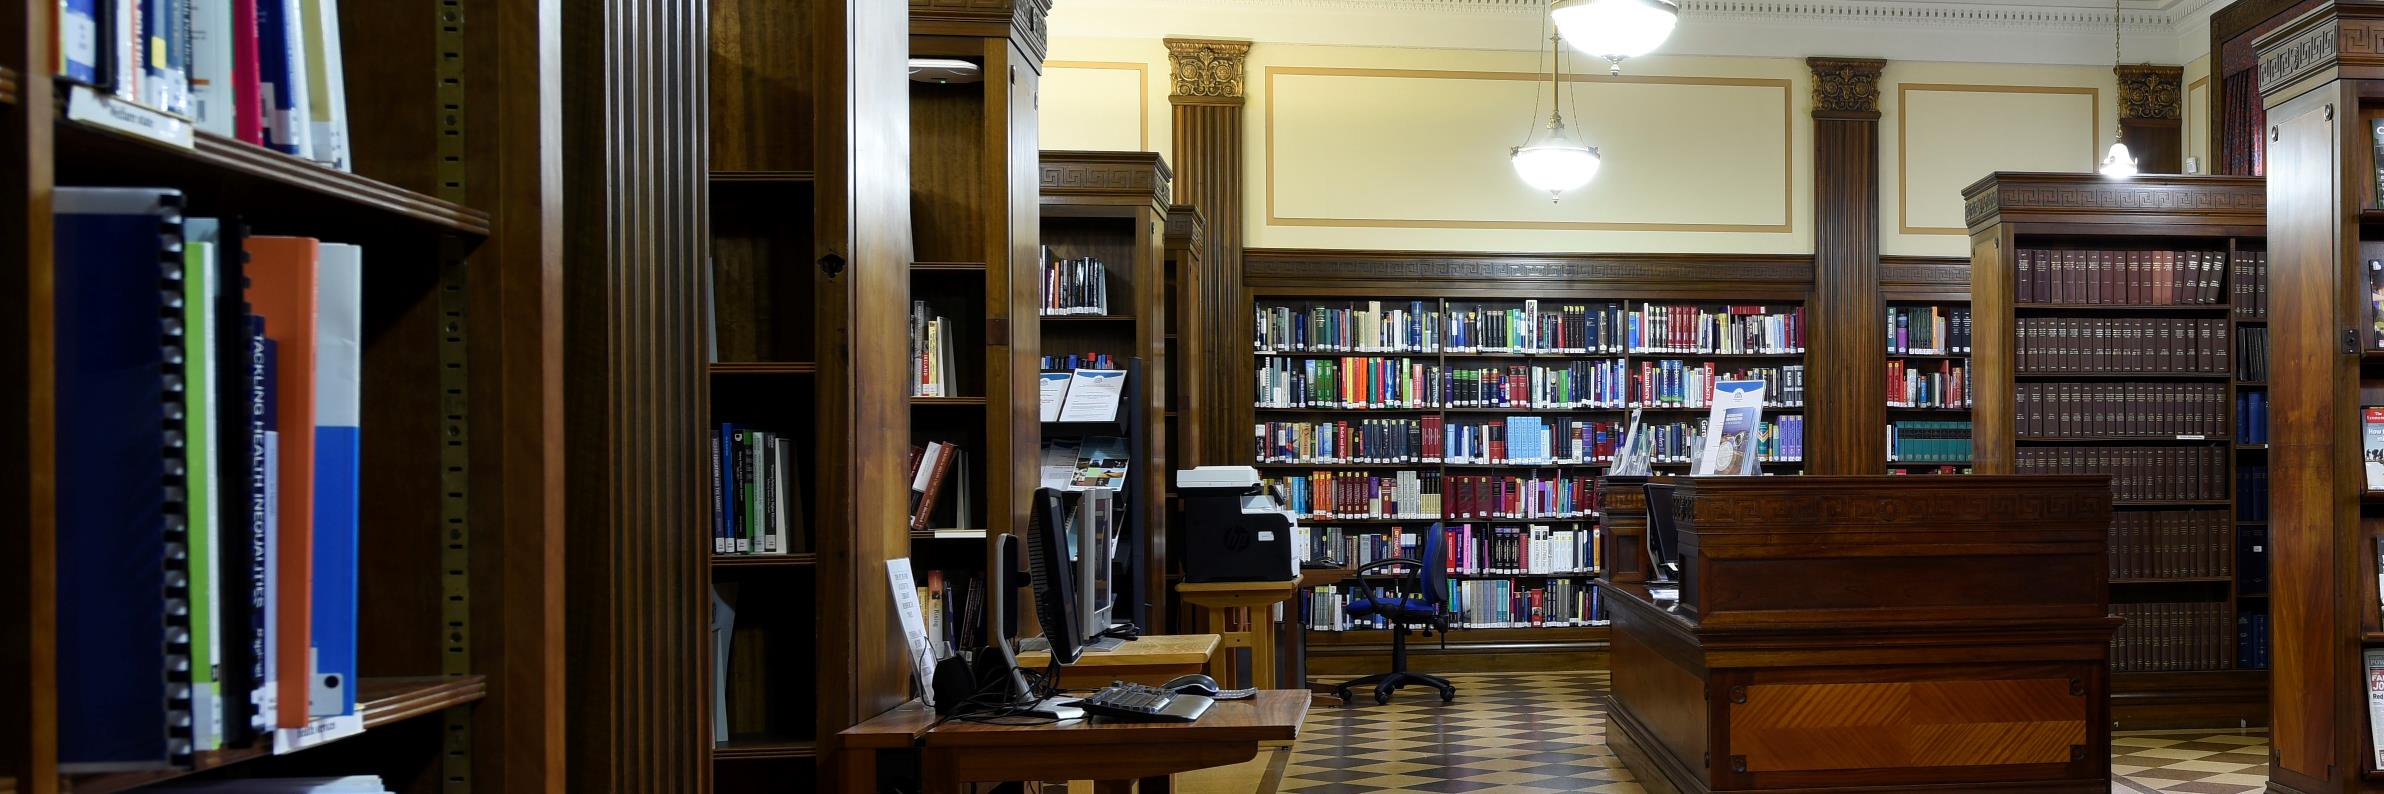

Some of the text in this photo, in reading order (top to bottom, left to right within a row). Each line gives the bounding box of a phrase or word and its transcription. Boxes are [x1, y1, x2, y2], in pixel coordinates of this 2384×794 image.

[252, 333, 266, 415] TACKLING
[252, 420, 266, 487] HEALTH
[252, 493, 266, 608] INEQUALITIES
